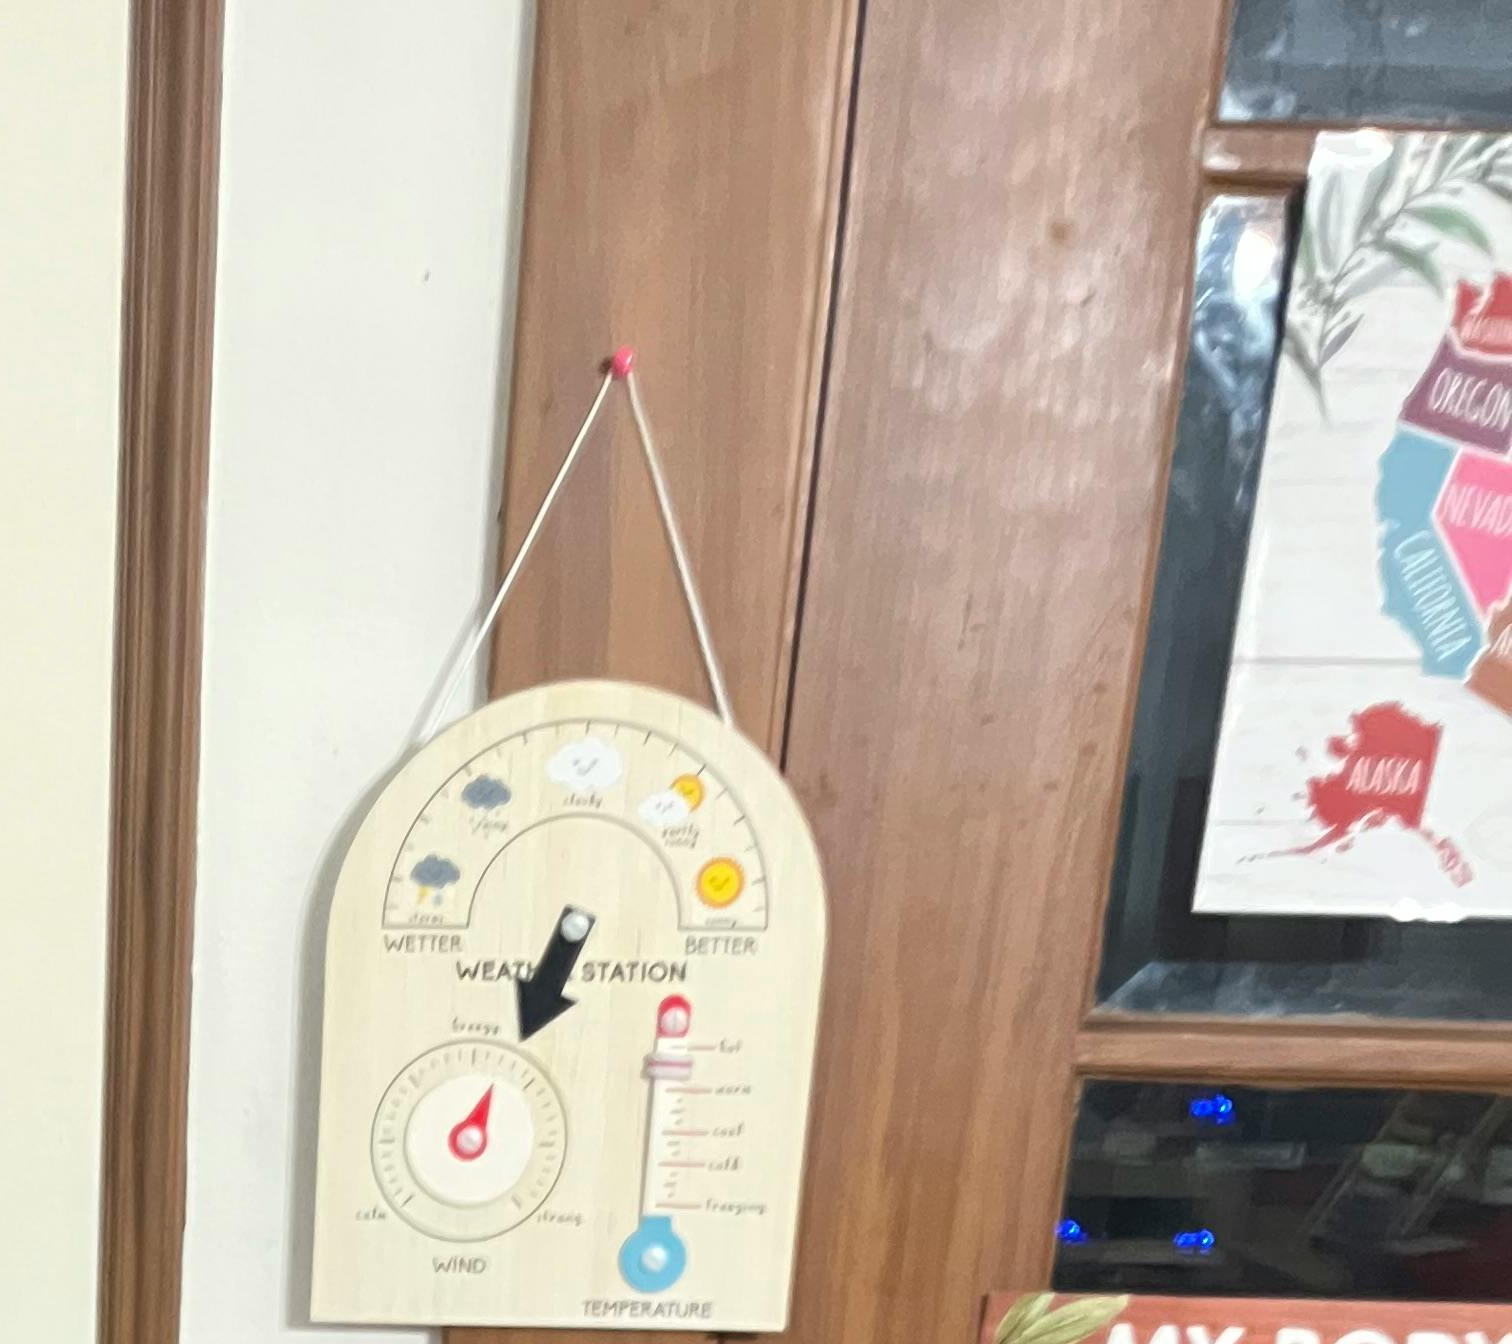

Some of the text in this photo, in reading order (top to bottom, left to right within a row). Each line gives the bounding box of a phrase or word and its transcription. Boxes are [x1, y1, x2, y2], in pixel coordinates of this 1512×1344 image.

[1394, 529, 1472, 663] CALIFORNIA
[1346, 757, 1423, 793] ALASKA
[384, 935, 463, 953] WETTER
[685, 937, 757, 955] BETTER
[583, 962, 687, 982] STATION
[432, 1257, 486, 1274] WIND
[583, 1300, 713, 1318] TEMPERATURE
